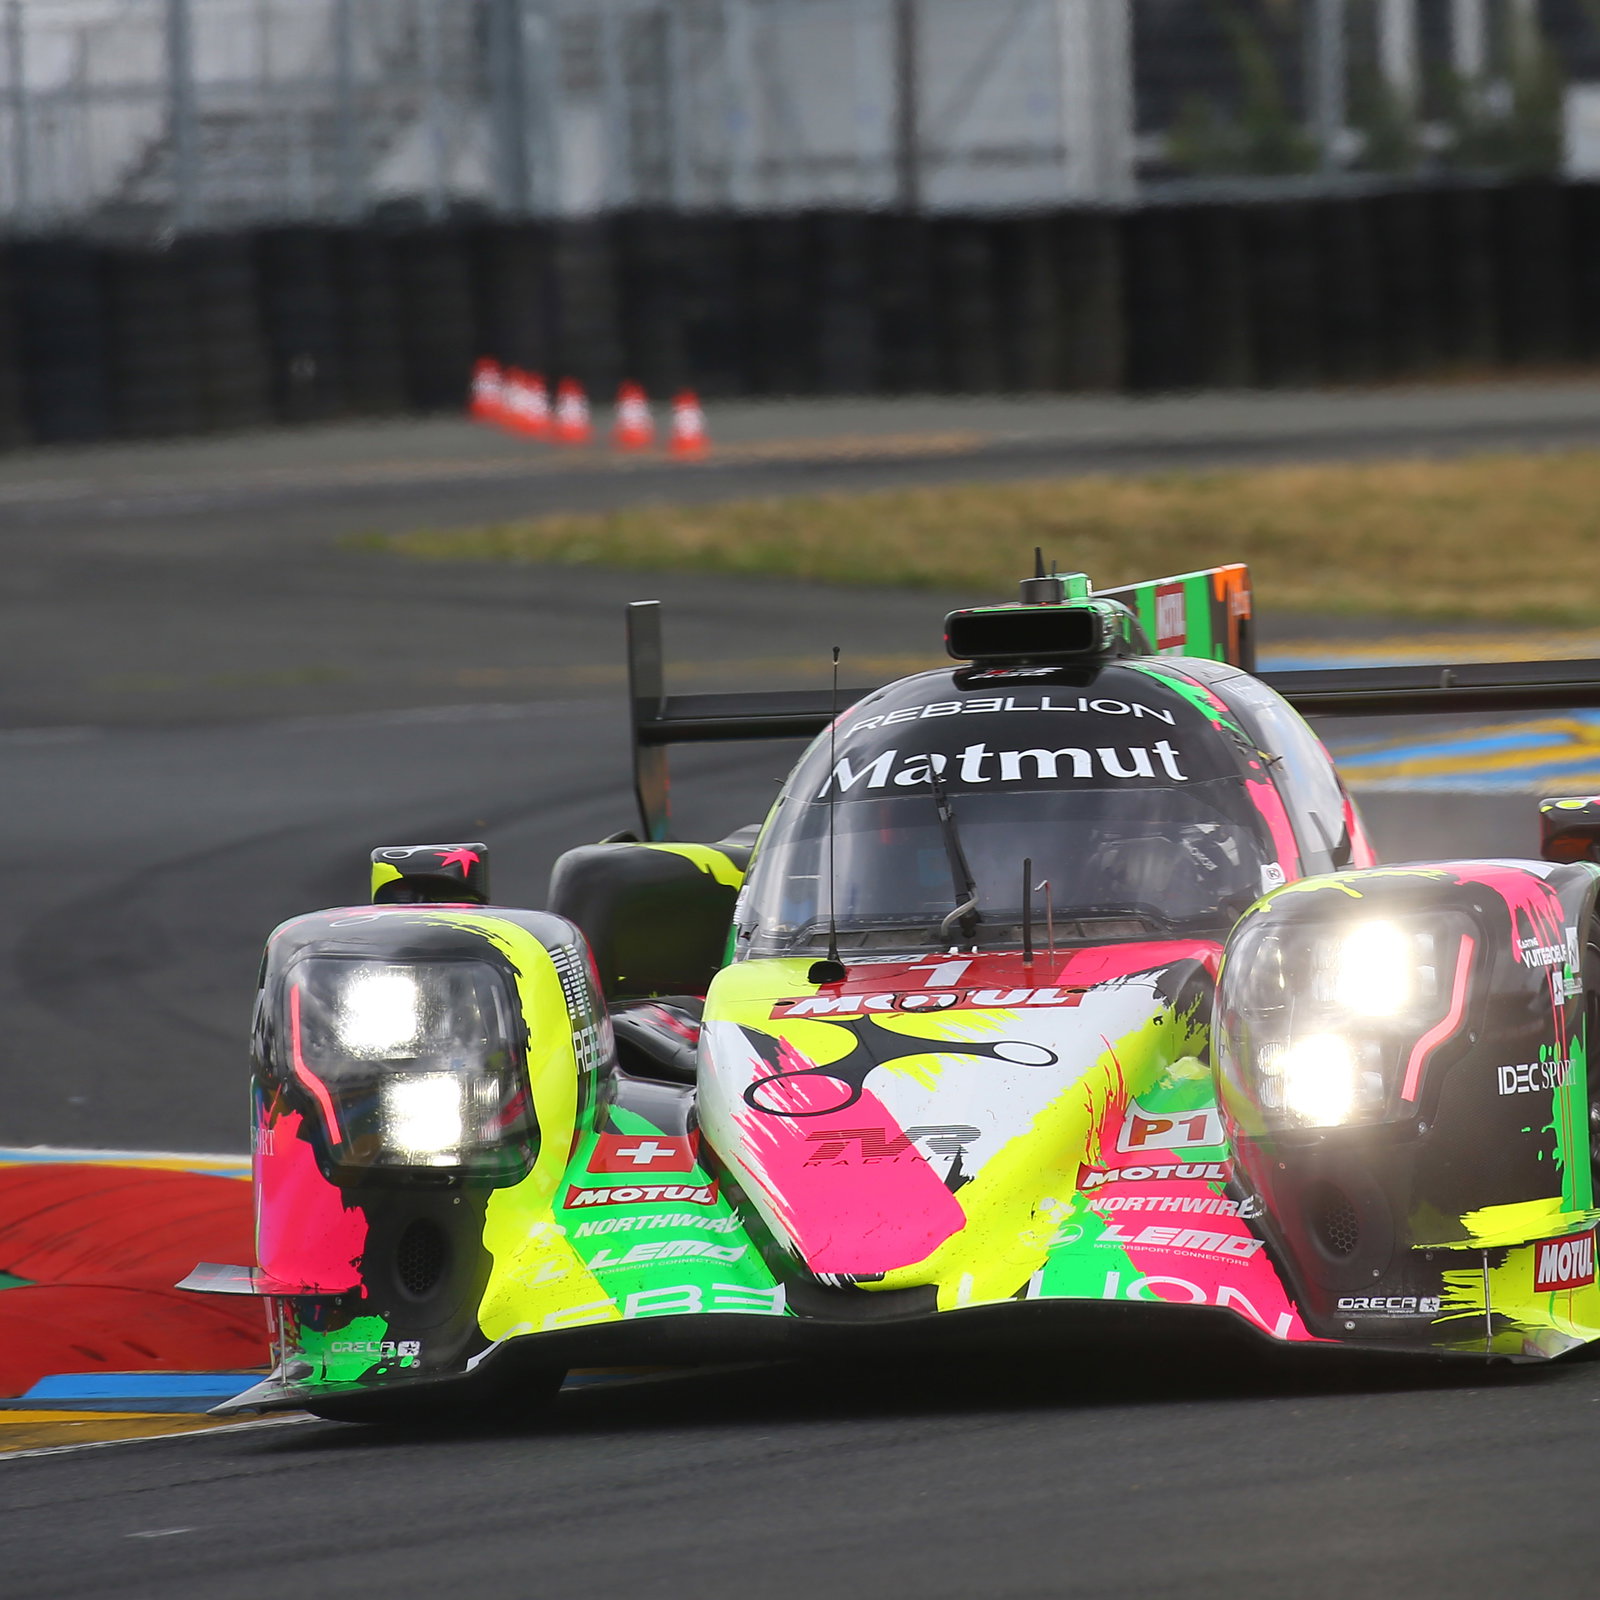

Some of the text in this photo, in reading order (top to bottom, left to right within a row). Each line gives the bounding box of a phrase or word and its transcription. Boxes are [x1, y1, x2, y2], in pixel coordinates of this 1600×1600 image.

[817, 739, 1188, 799] Matmut
[909, 960, 973, 987] 1
[1497, 1058, 1577, 1095] IDEC SPORT
[1128, 1114, 1208, 1147] P1
[1081, 1164, 1225, 1189] MOTUL
[570, 1185, 713, 1207] MOTUL
[1083, 1194, 1254, 1219] NORTHWIRE
[585, 1239, 749, 1271] LEMO
[1093, 1243, 1250, 1267] MOTORSPORT CONNECTORS
[1095, 1224, 1266, 1259] LEMO
[1537, 1241, 1594, 1284] MOTUL
[1337, 1297, 1418, 1310] ORECA
[331, 1341, 397, 1354] ORECA
